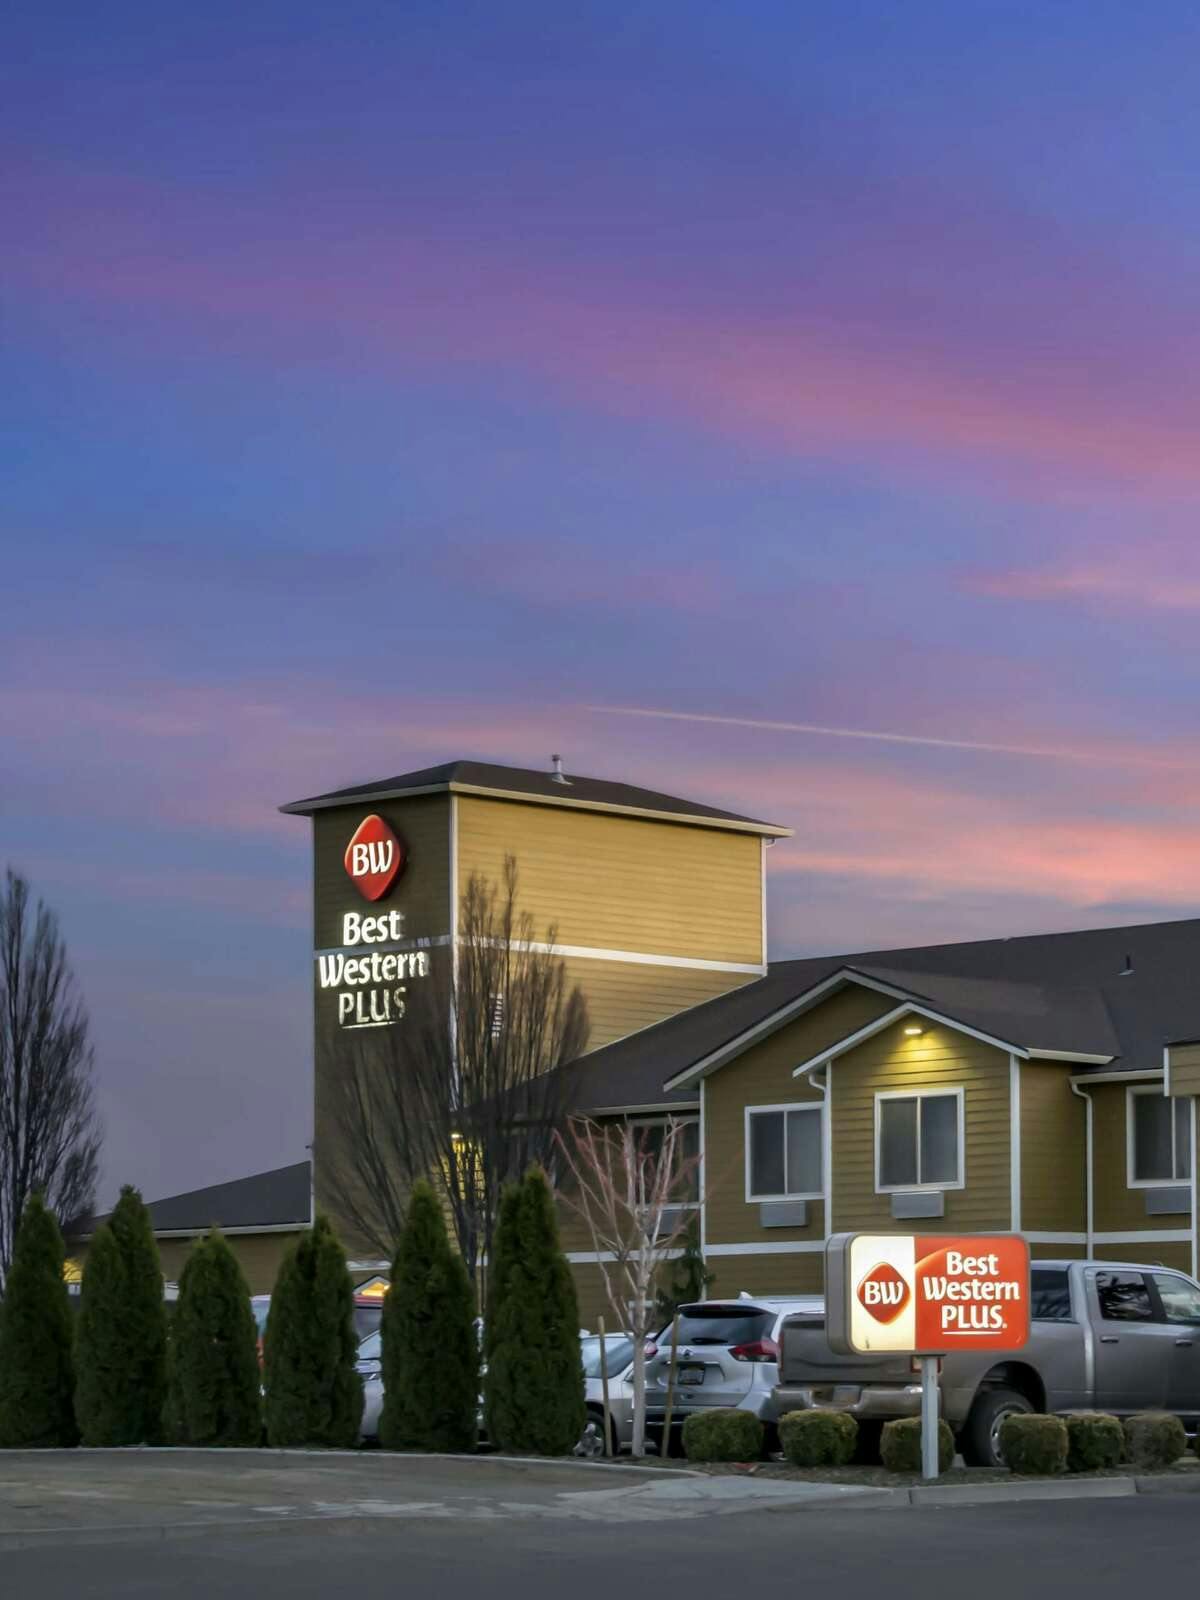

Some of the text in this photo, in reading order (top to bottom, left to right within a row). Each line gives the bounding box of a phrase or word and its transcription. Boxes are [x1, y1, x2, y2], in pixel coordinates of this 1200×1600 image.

[352, 839, 393, 876] BW
[342, 911, 402, 946] Best
[319, 951, 427, 989] Western
[946, 1251, 999, 1275] Best
[864, 1281, 904, 1305] BW
[922, 1276, 1020, 1301] Western
